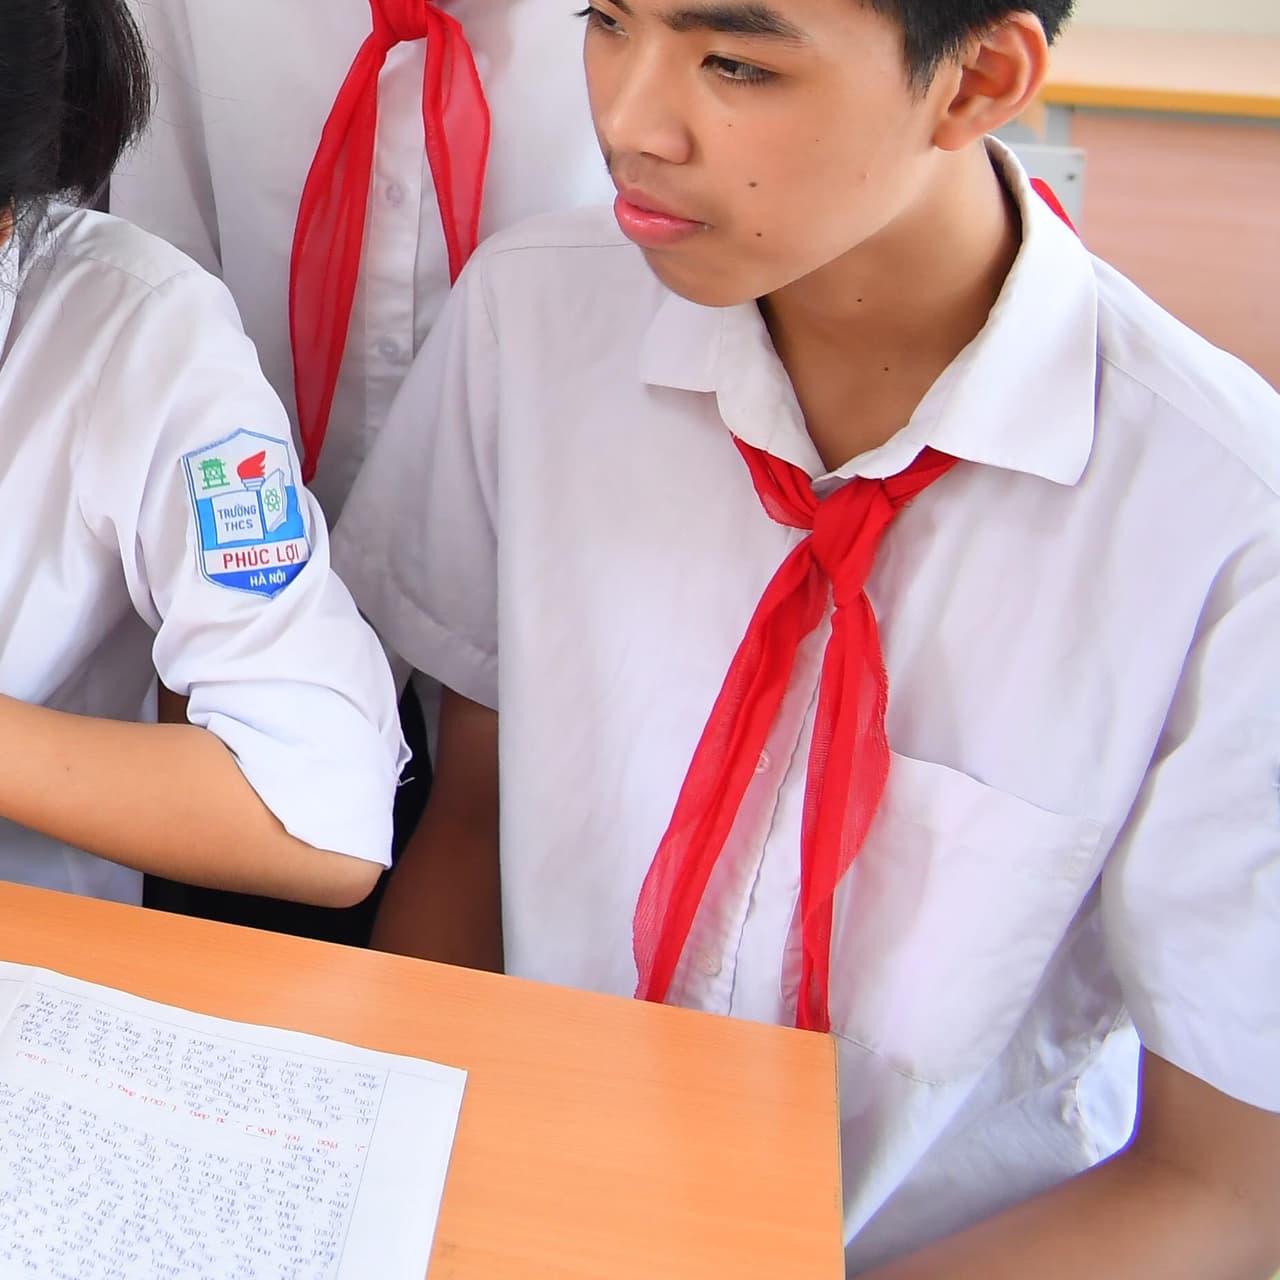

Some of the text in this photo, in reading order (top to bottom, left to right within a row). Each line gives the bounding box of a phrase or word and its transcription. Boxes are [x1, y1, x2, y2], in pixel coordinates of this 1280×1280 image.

[217, 504, 257, 521] TRƯỜNG
[225, 519, 254, 533] THCS
[222, 543, 300, 569] PHÚC LỢI
[249, 570, 287, 587] HÀ NỘI
